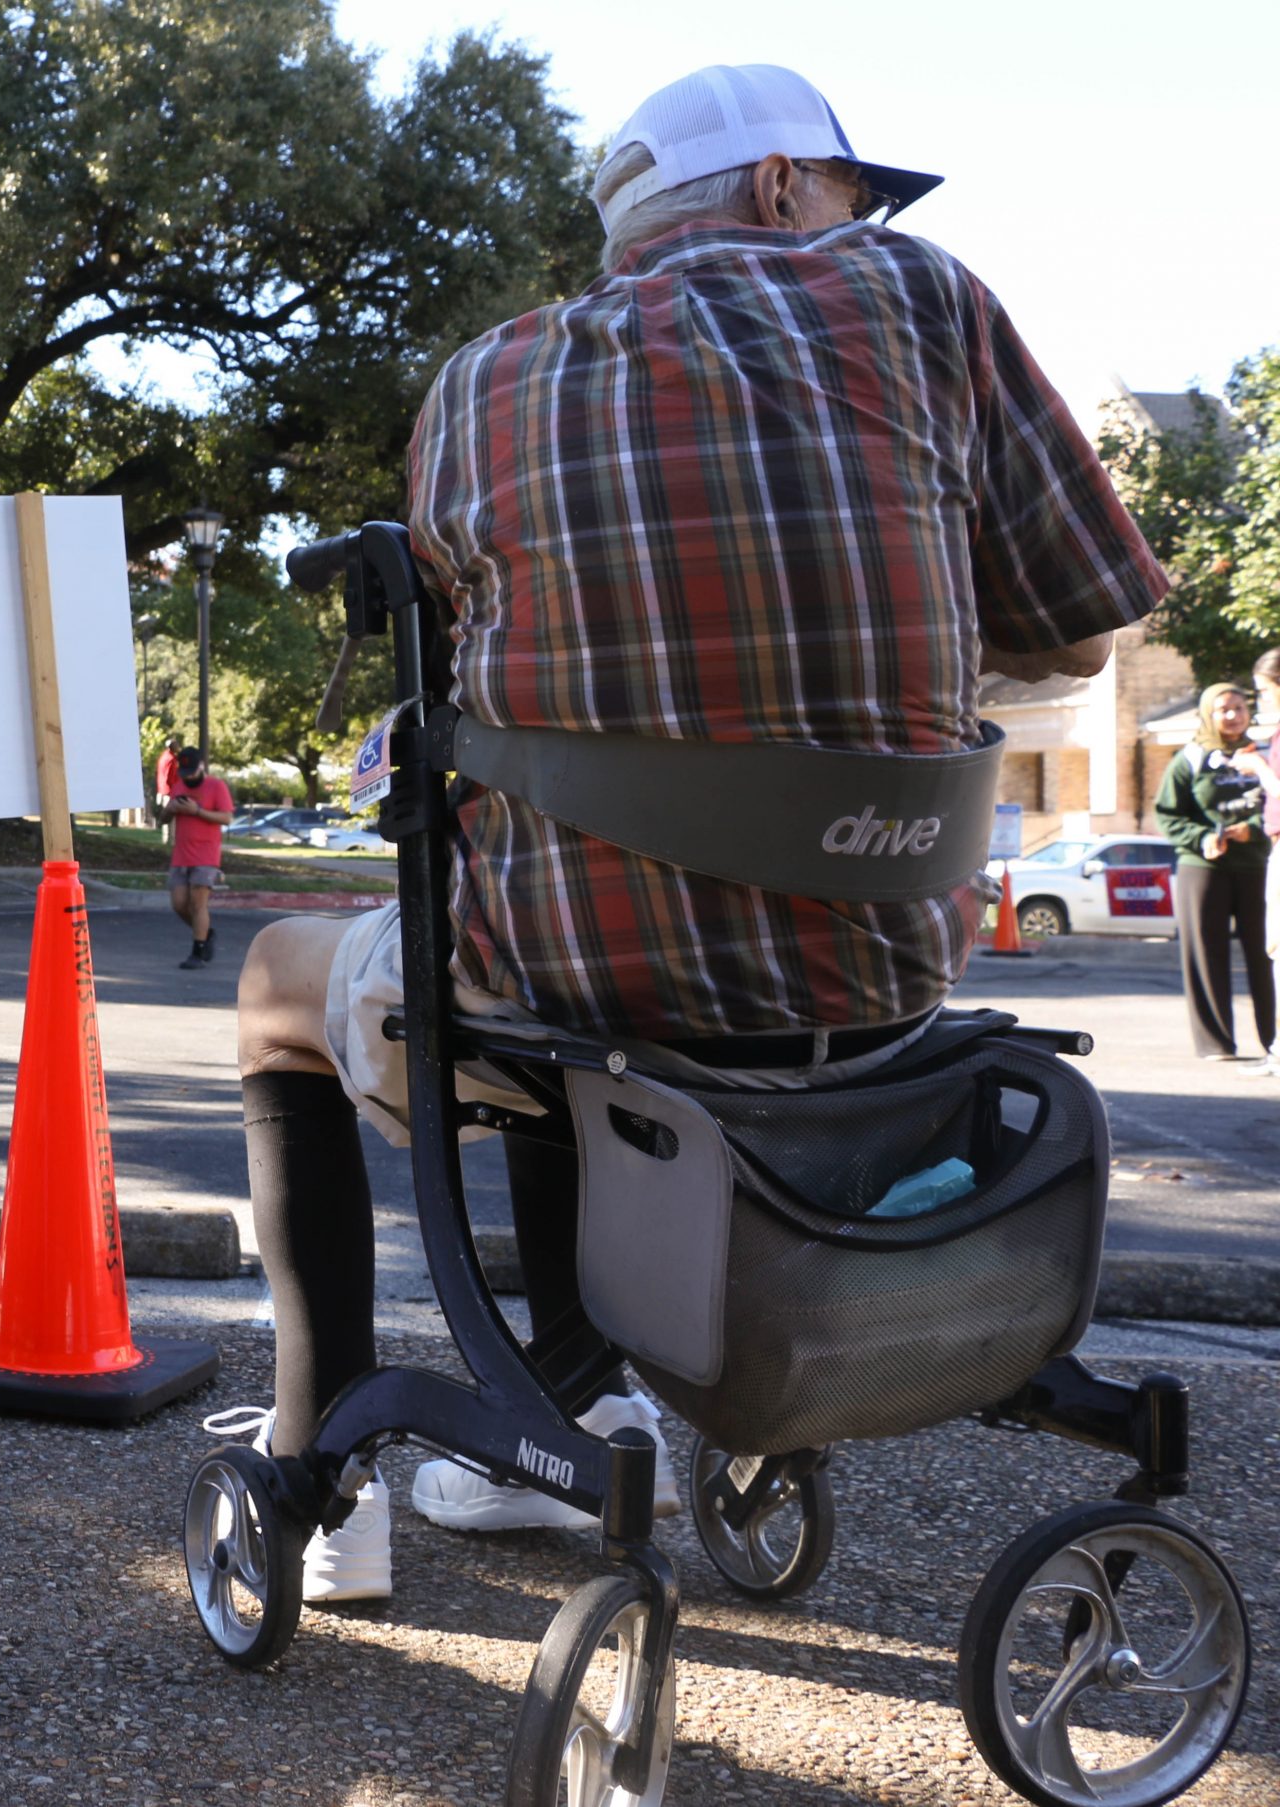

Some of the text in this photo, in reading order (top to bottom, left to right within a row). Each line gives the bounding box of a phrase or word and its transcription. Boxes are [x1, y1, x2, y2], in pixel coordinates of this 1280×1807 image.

[822, 805, 940, 856] drive
[63, 905, 94, 1003] TRAVIS
[517, 1437, 574, 1490] NITRO
